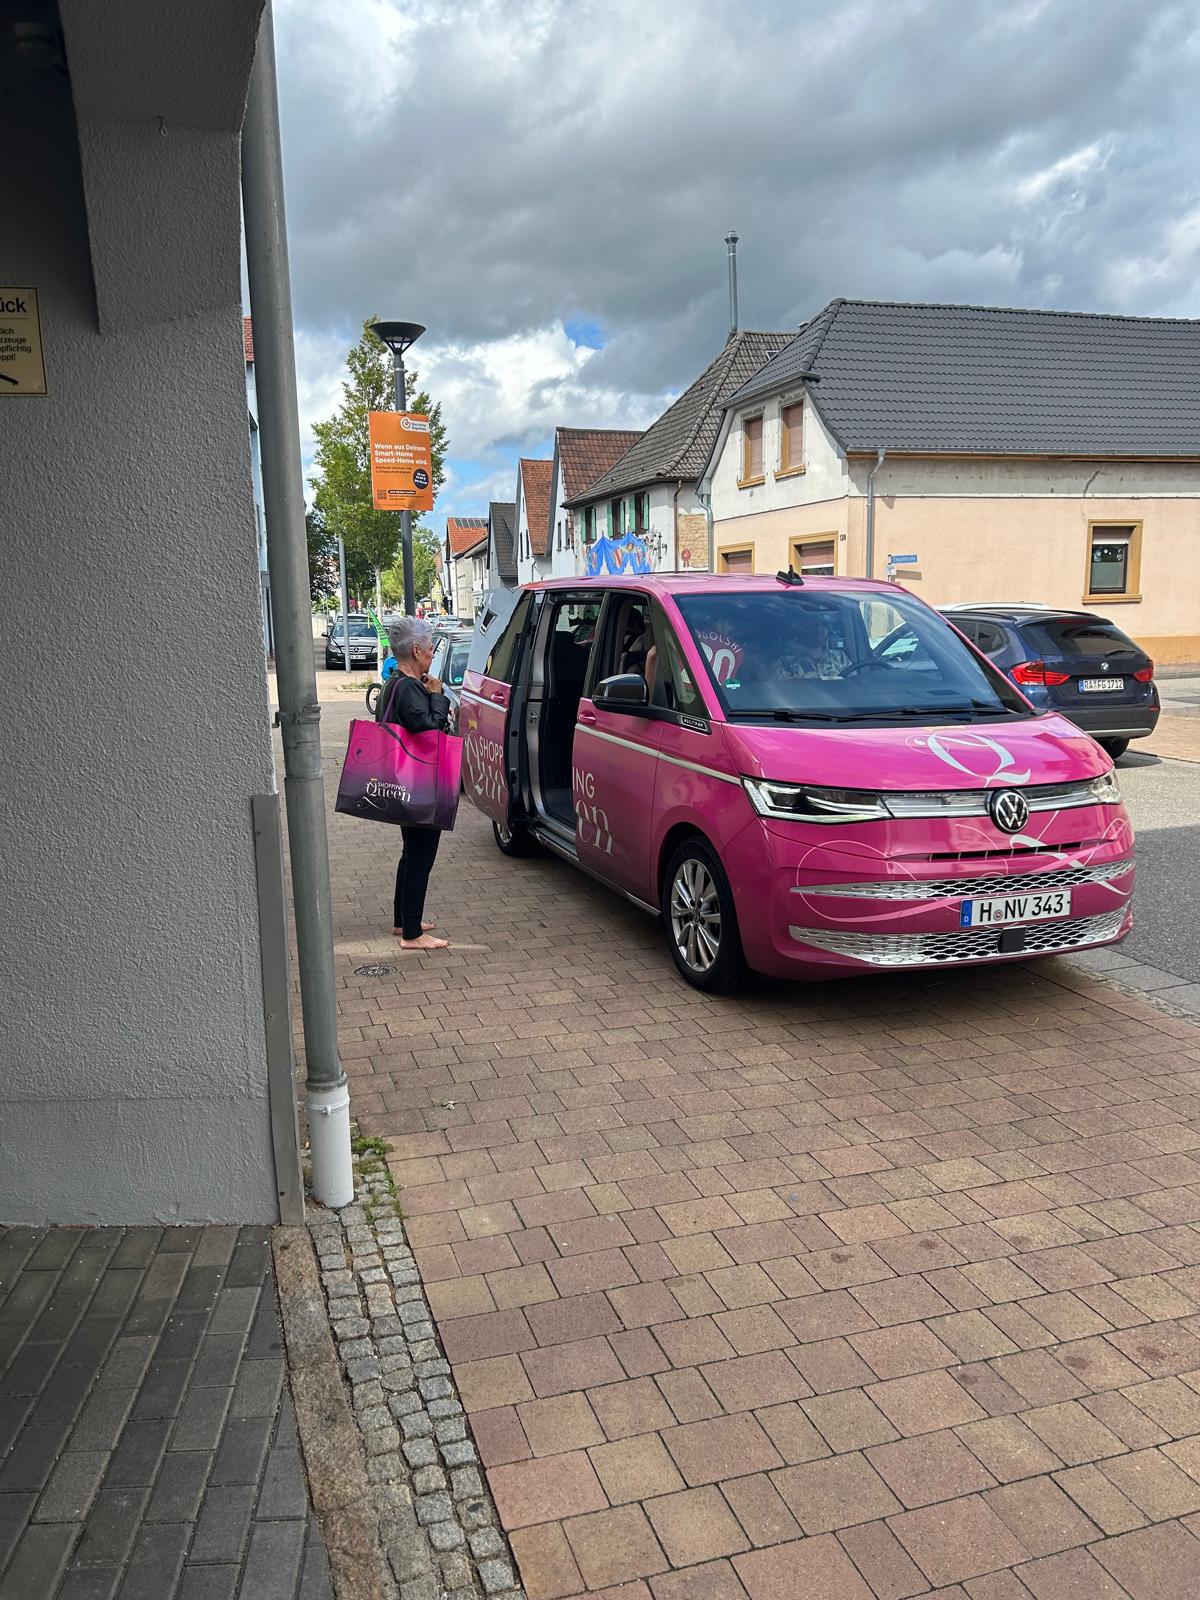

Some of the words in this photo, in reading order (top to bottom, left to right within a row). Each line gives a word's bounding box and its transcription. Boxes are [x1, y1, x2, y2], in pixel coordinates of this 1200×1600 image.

[0, 345, 32, 354] pflichtig
[0, 353, 16, 362] ppt!
[479, 735, 504, 766] SHOPP
[362, 781, 411, 807] Queen
[377, 781, 407, 792] SHOPPING
[572, 766, 595, 799] ING
[575, 799, 613, 856] en
[979, 902, 992, 922] H
[1004, 897, 1029, 918] NV
[1031, 893, 1064, 915] 343
